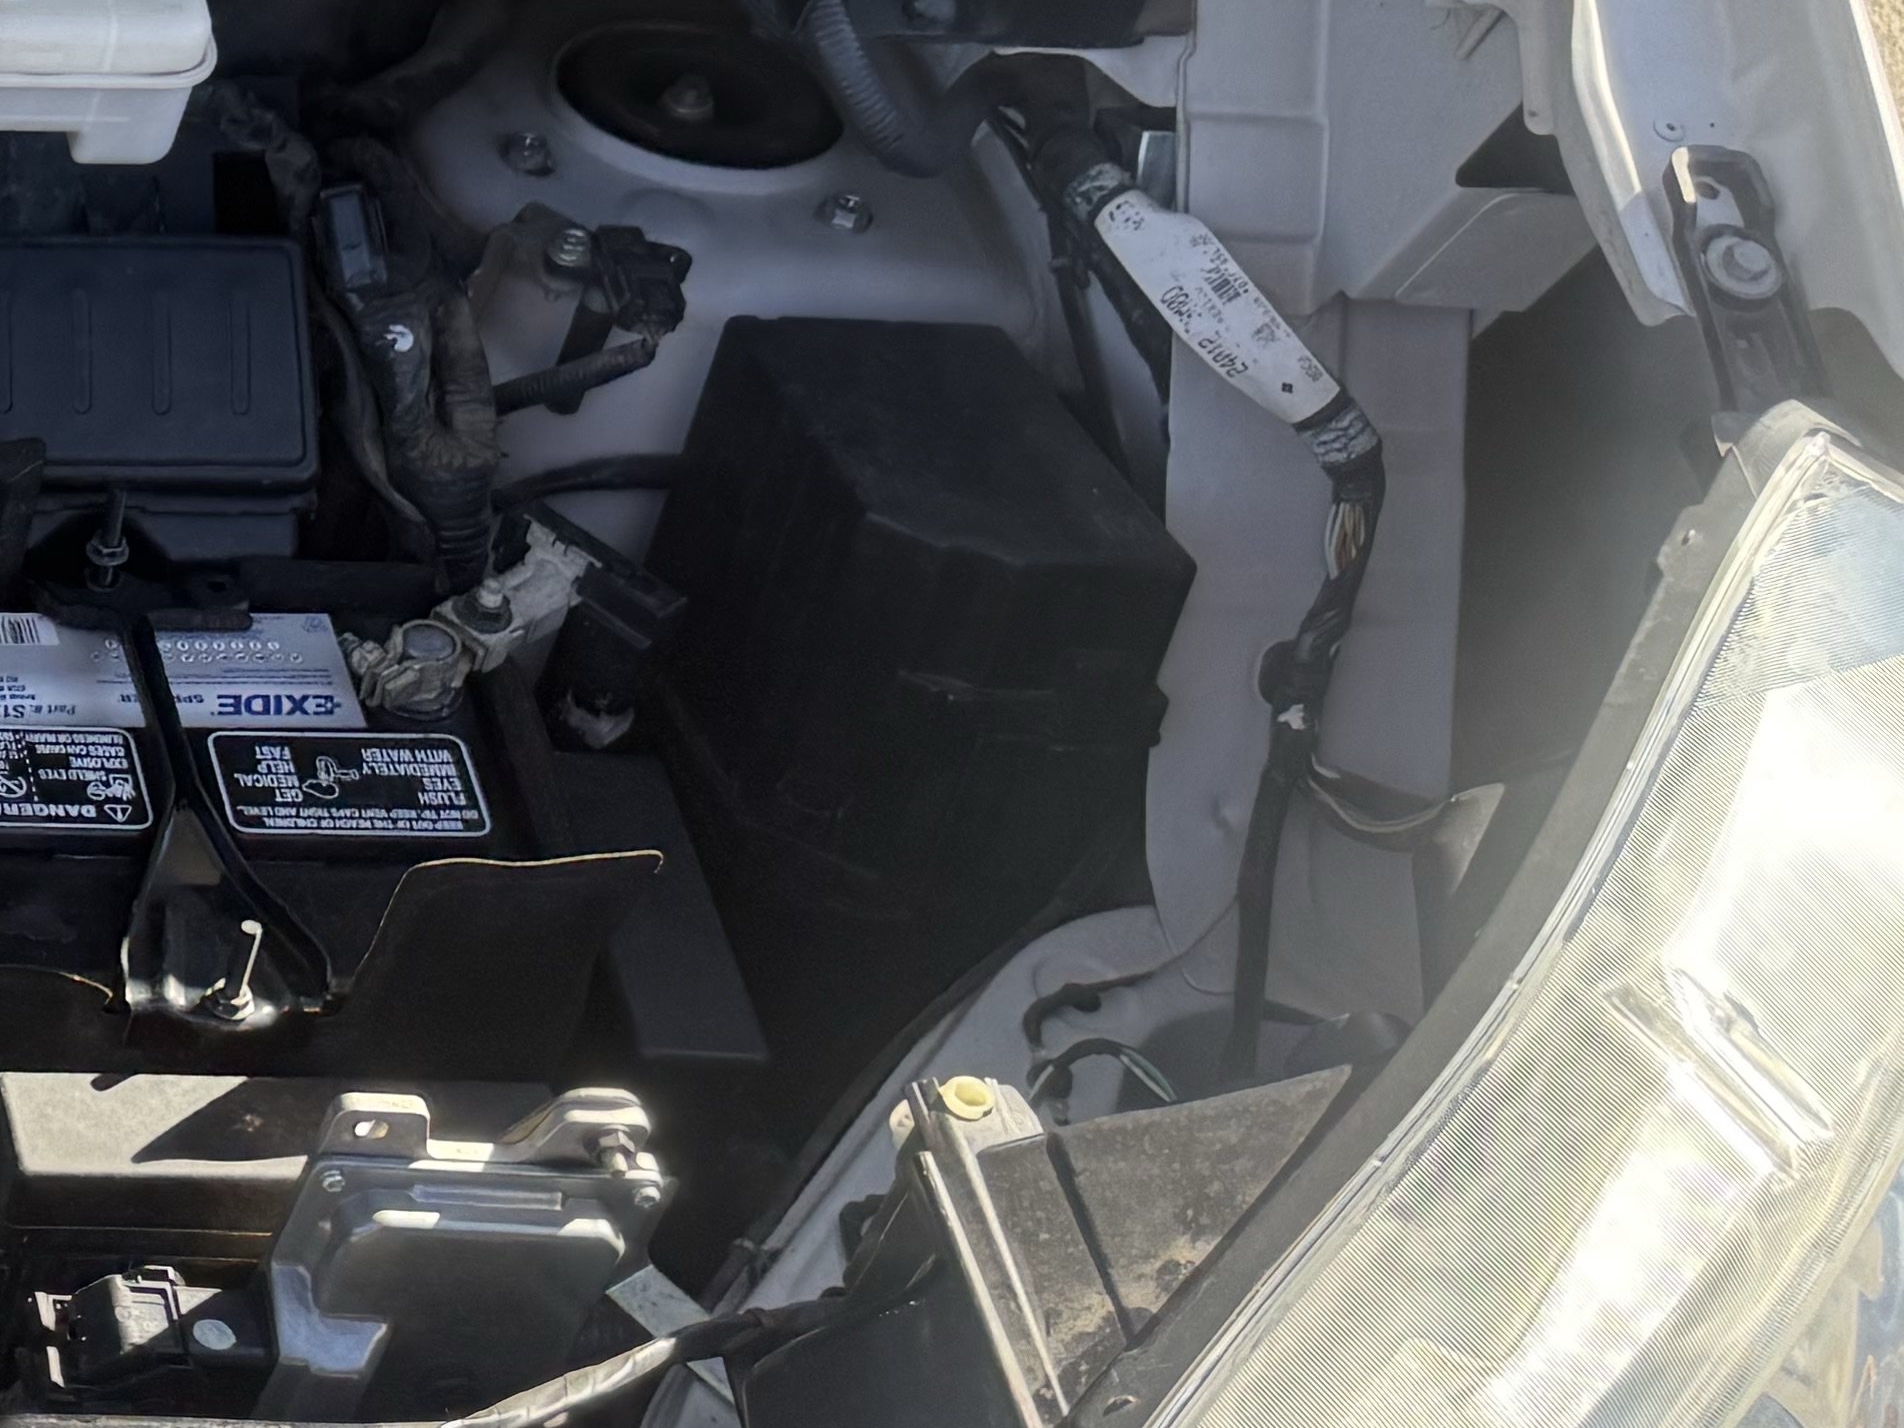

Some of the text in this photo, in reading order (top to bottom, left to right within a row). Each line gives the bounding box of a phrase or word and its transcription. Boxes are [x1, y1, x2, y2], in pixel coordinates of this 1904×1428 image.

[47, 704, 76, 716] Part
[216, 694, 339, 716] EXIDE
[254, 746, 291, 760] FAST
[361, 748, 454, 763] WITH WATER
[257, 760, 295, 774] HELP
[362, 762, 457, 777] IMMEDIATELY
[233, 773, 300, 787] MEDICAL
[421, 778, 462, 791] EYES
[274, 788, 303, 802] GET
[417, 792, 467, 806] FLUSH
